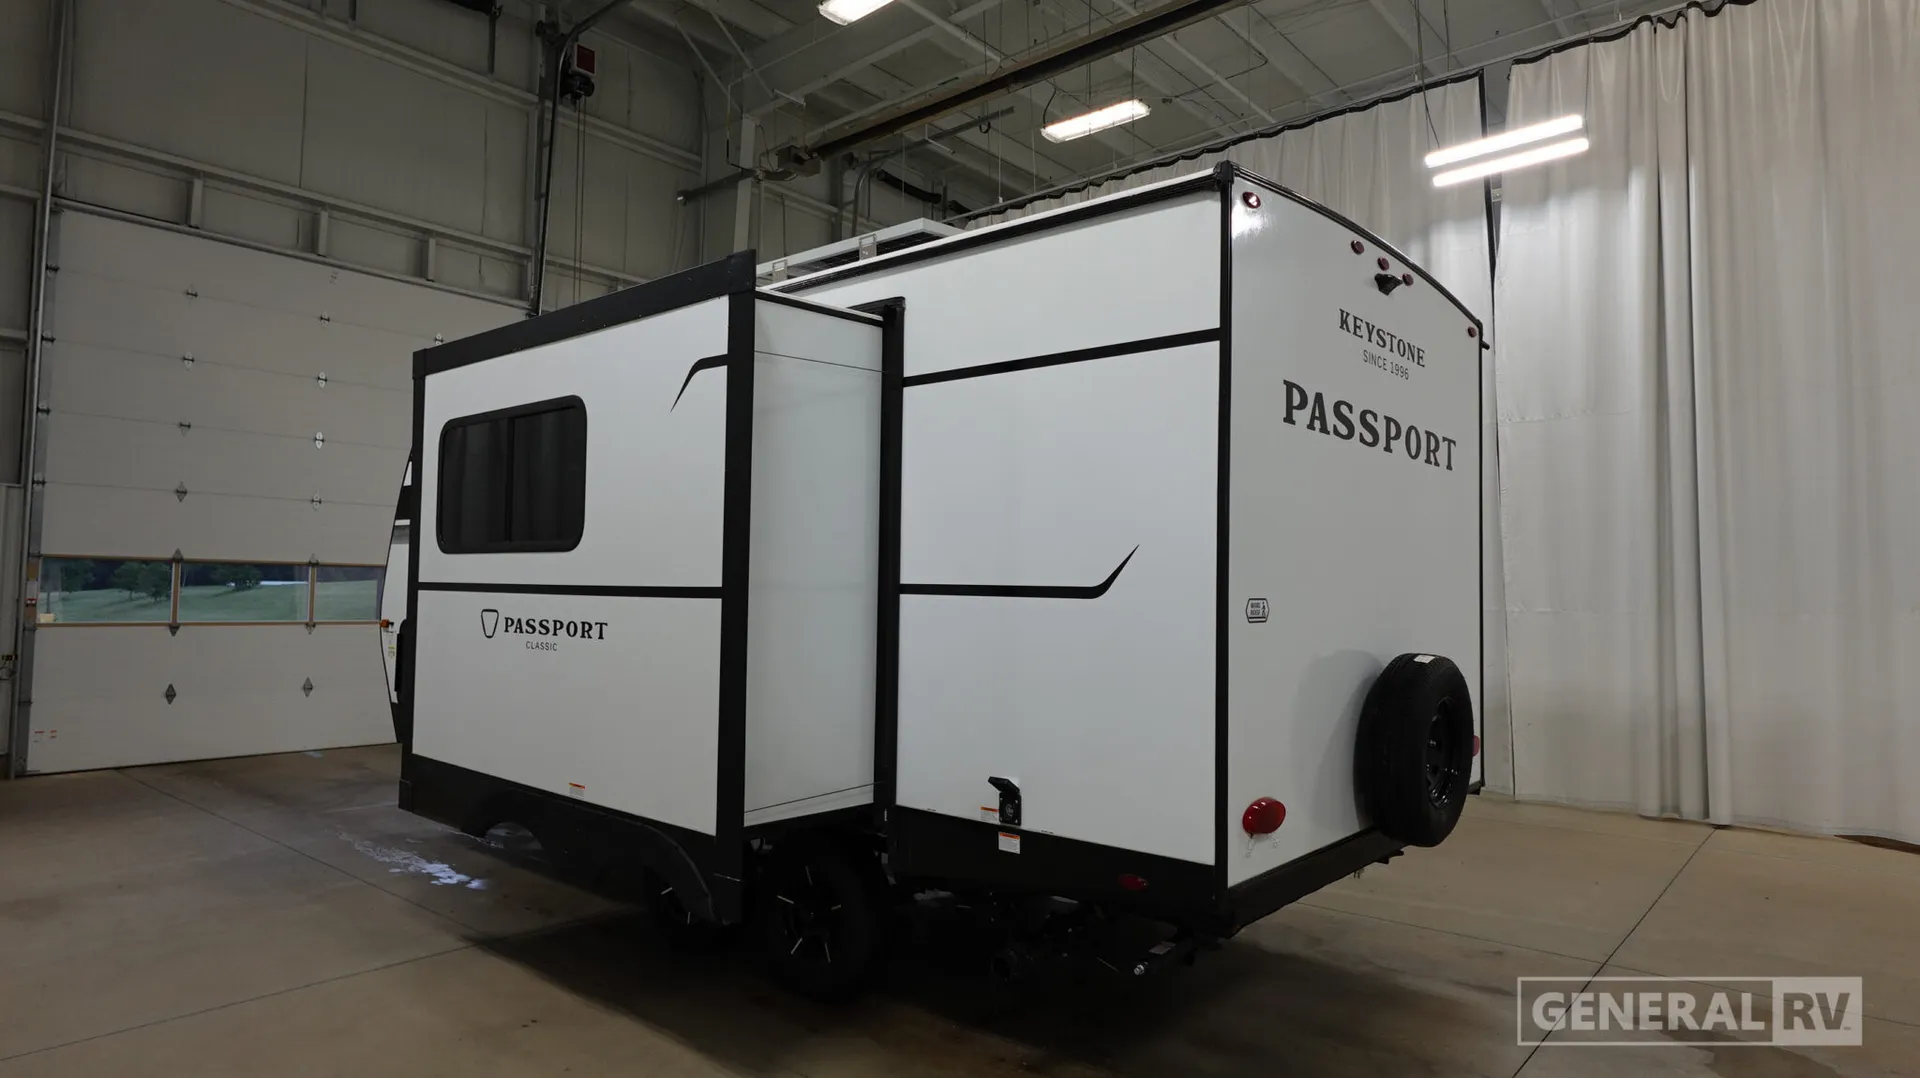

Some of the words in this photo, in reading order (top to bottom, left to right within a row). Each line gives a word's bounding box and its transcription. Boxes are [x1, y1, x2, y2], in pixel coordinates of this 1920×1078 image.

[1339, 308, 1425, 368] KEYSTONE
[1363, 349, 1387, 371] SINCE
[1390, 361, 1409, 380] 1996
[1283, 379, 1456, 471] PASSPORT
[504, 616, 608, 640] PASSPORT
[525, 640, 558, 652] CLASSIC
